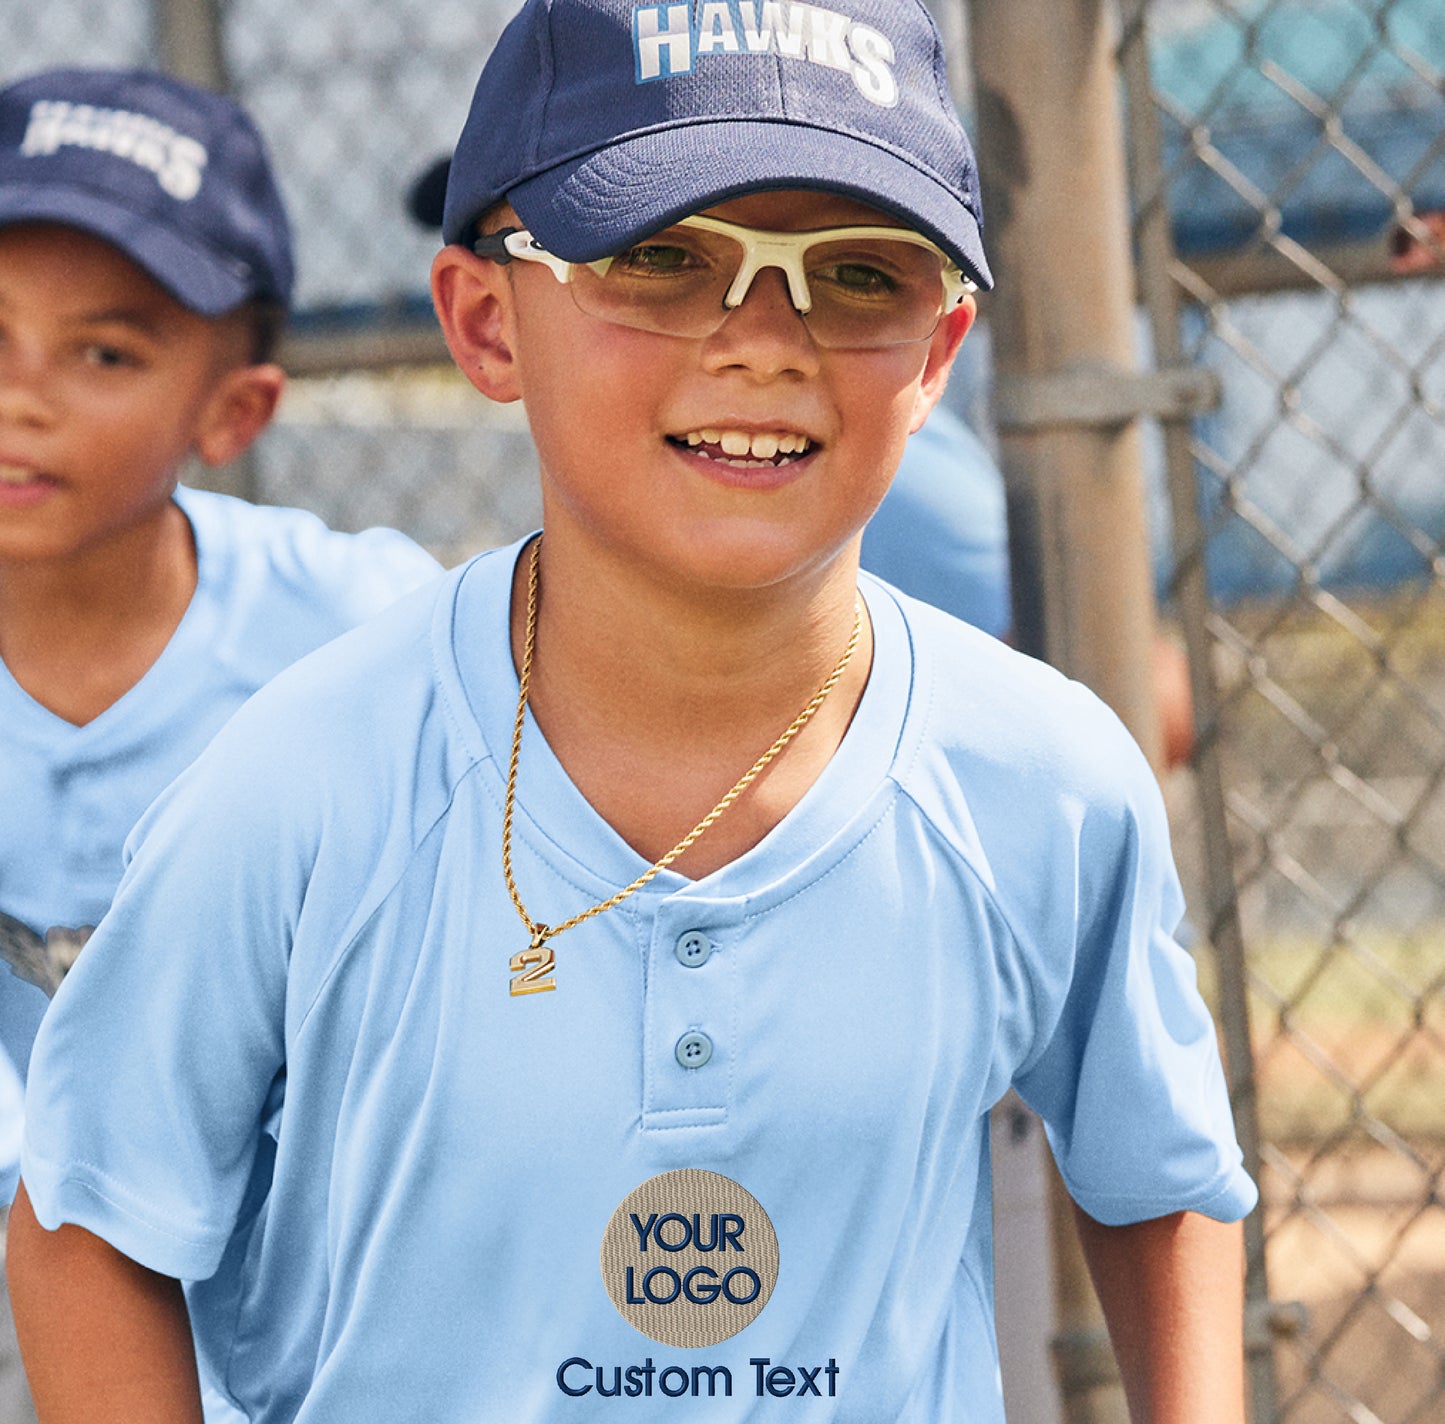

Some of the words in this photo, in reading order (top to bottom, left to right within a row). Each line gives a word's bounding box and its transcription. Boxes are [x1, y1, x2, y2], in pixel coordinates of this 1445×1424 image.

[632, 1, 898, 108] HAWKS
[509, 946, 556, 997] 2
[629, 1212, 745, 1253] YOUR
[626, 1265, 762, 1305] LOGO
[556, 1356, 733, 1398] Custom
[749, 1357, 840, 1398] Text
